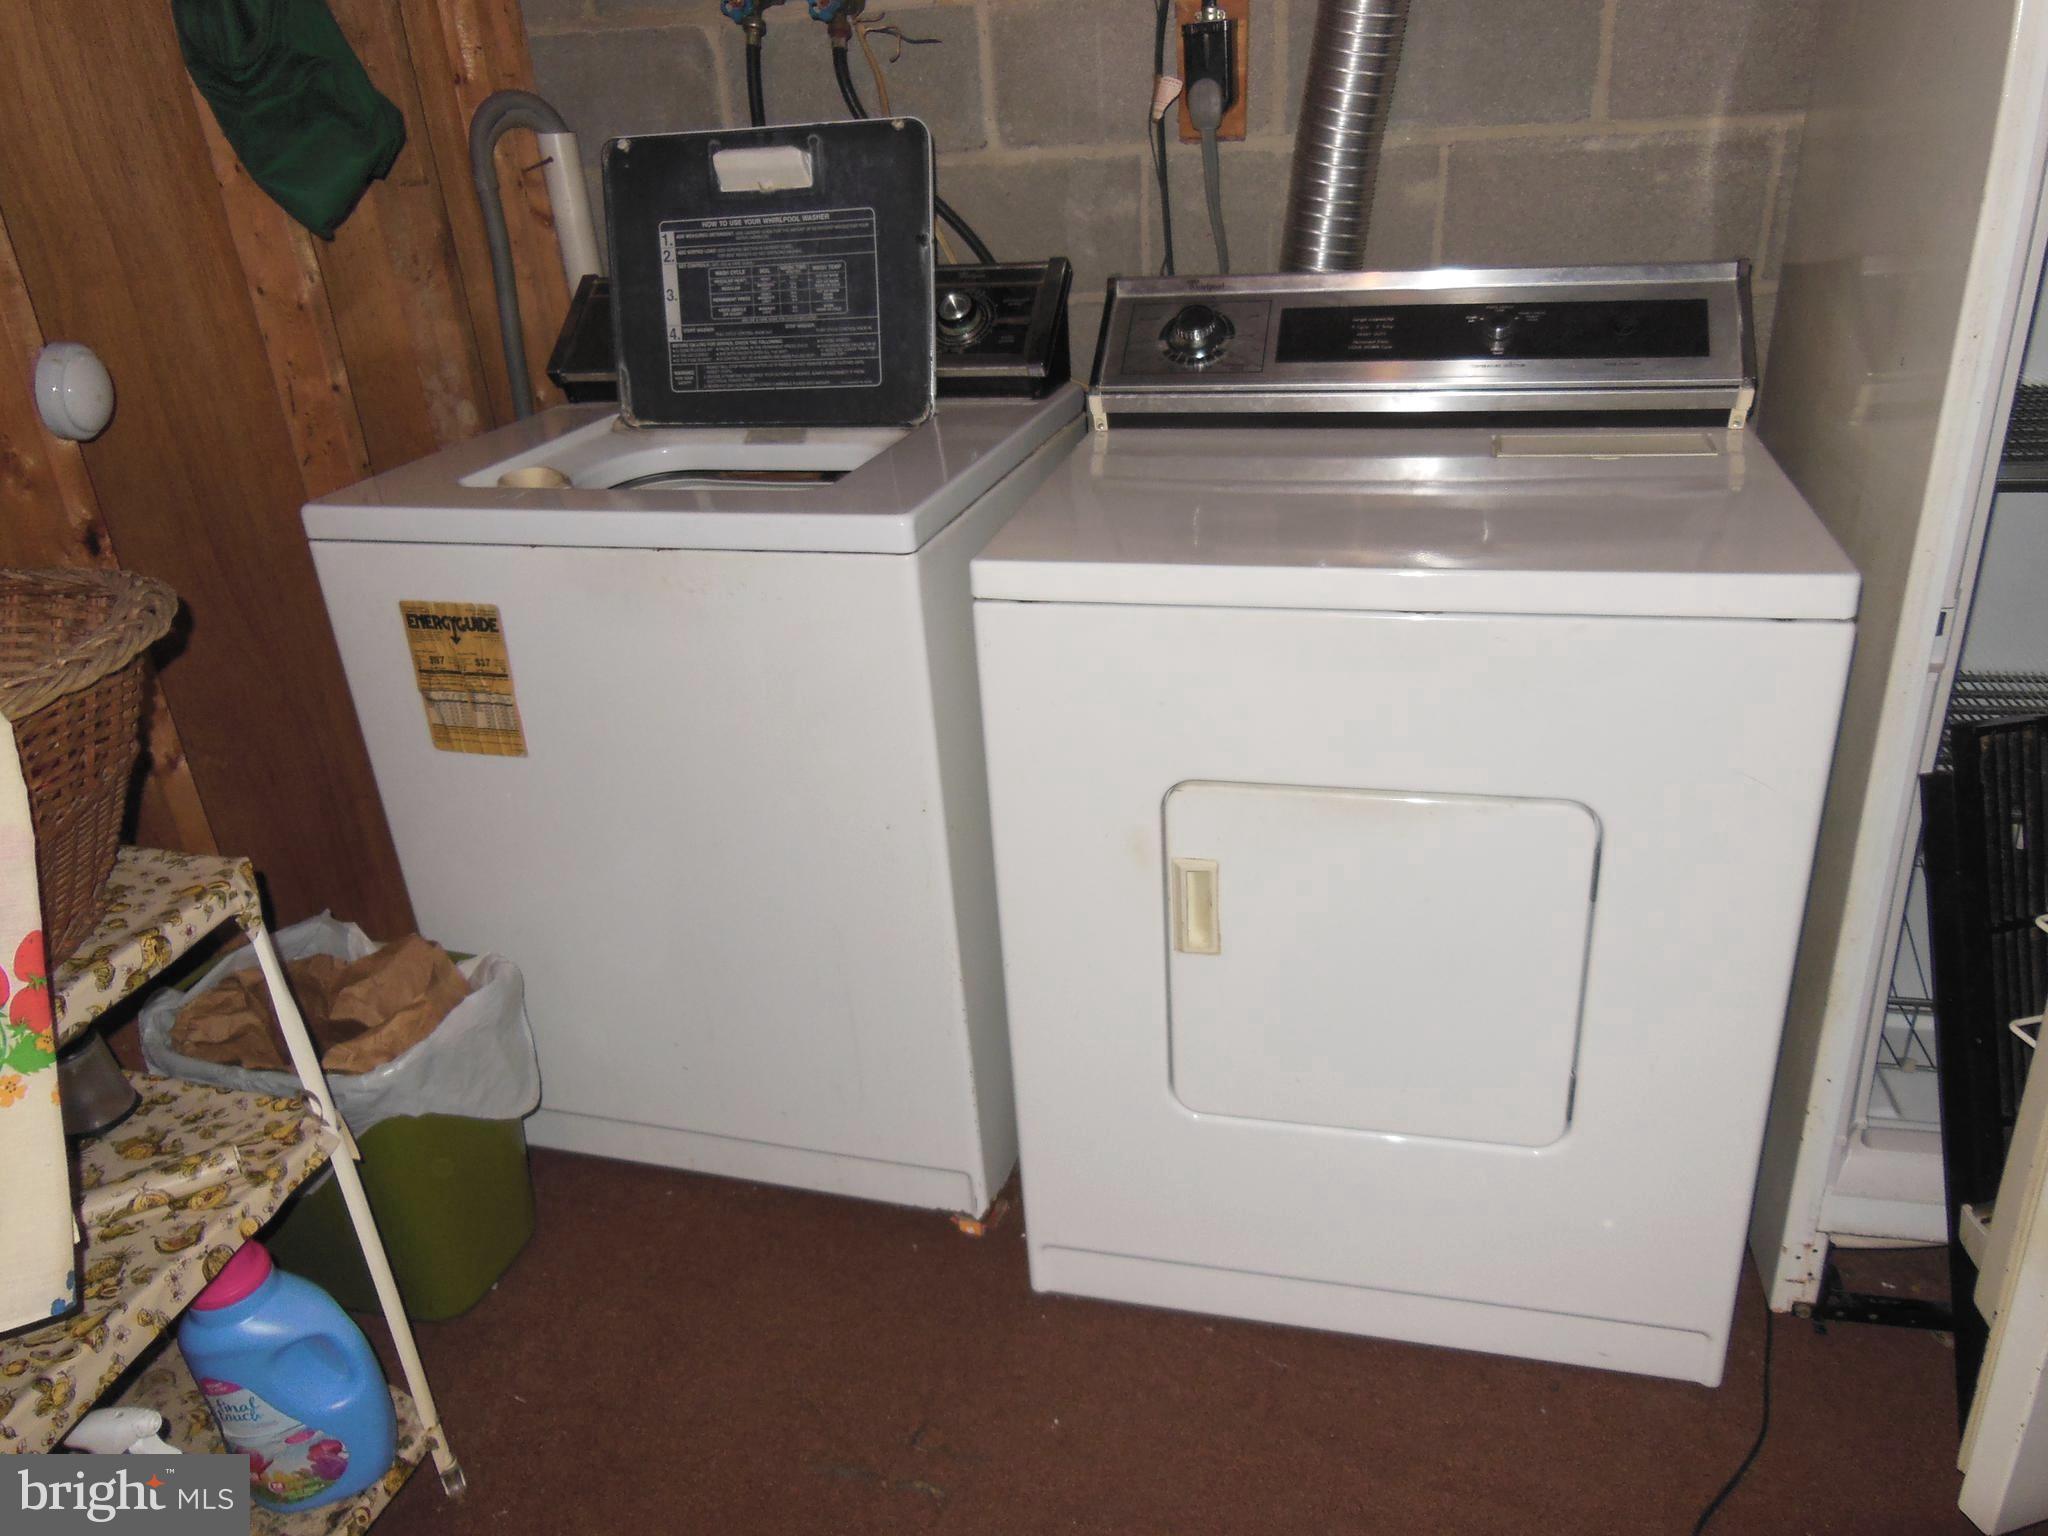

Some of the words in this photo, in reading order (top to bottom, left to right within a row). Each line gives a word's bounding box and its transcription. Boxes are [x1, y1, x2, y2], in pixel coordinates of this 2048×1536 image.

[701, 220, 718, 229] HOW
[719, 220, 728, 228] TO
[729, 218, 742, 227] USE
[744, 217, 762, 226] YOUR
[762, 215, 801, 225] WHIRLPOOL
[801, 212, 830, 222] WASHER
[661, 234, 673, 246] 1.
[663, 250, 675, 262] 2.
[666, 288, 678, 302] 3.
[669, 328, 681, 341] 4.
